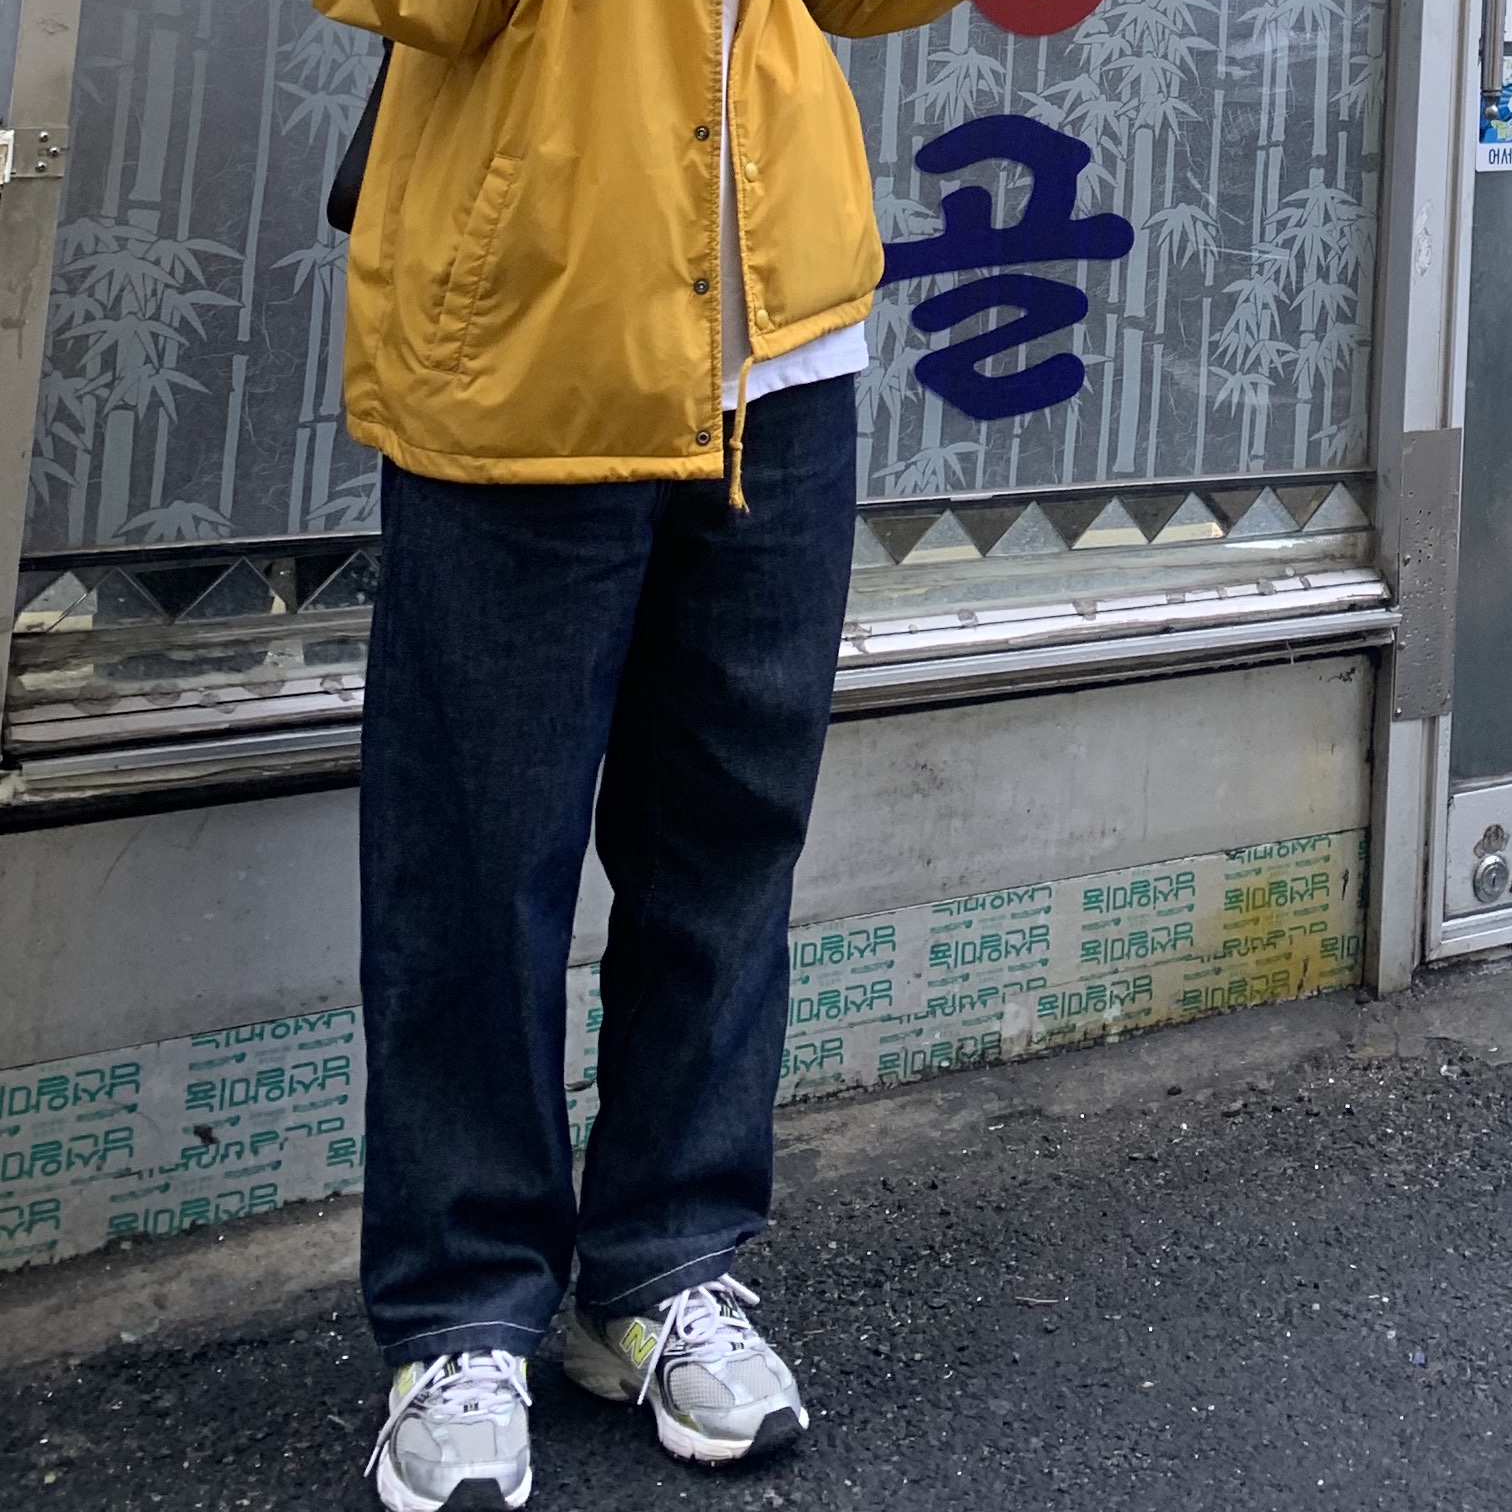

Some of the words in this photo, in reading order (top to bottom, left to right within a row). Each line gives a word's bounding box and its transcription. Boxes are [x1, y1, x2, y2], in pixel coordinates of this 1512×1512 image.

[878, 114, 1135, 421] 골
[793, 924, 896, 969] 남선알미
[789, 979, 893, 1026] 남선알미
[0, 1062, 140, 1121] 남선알미
[185, 1055, 351, 1114] 남선알미늄
